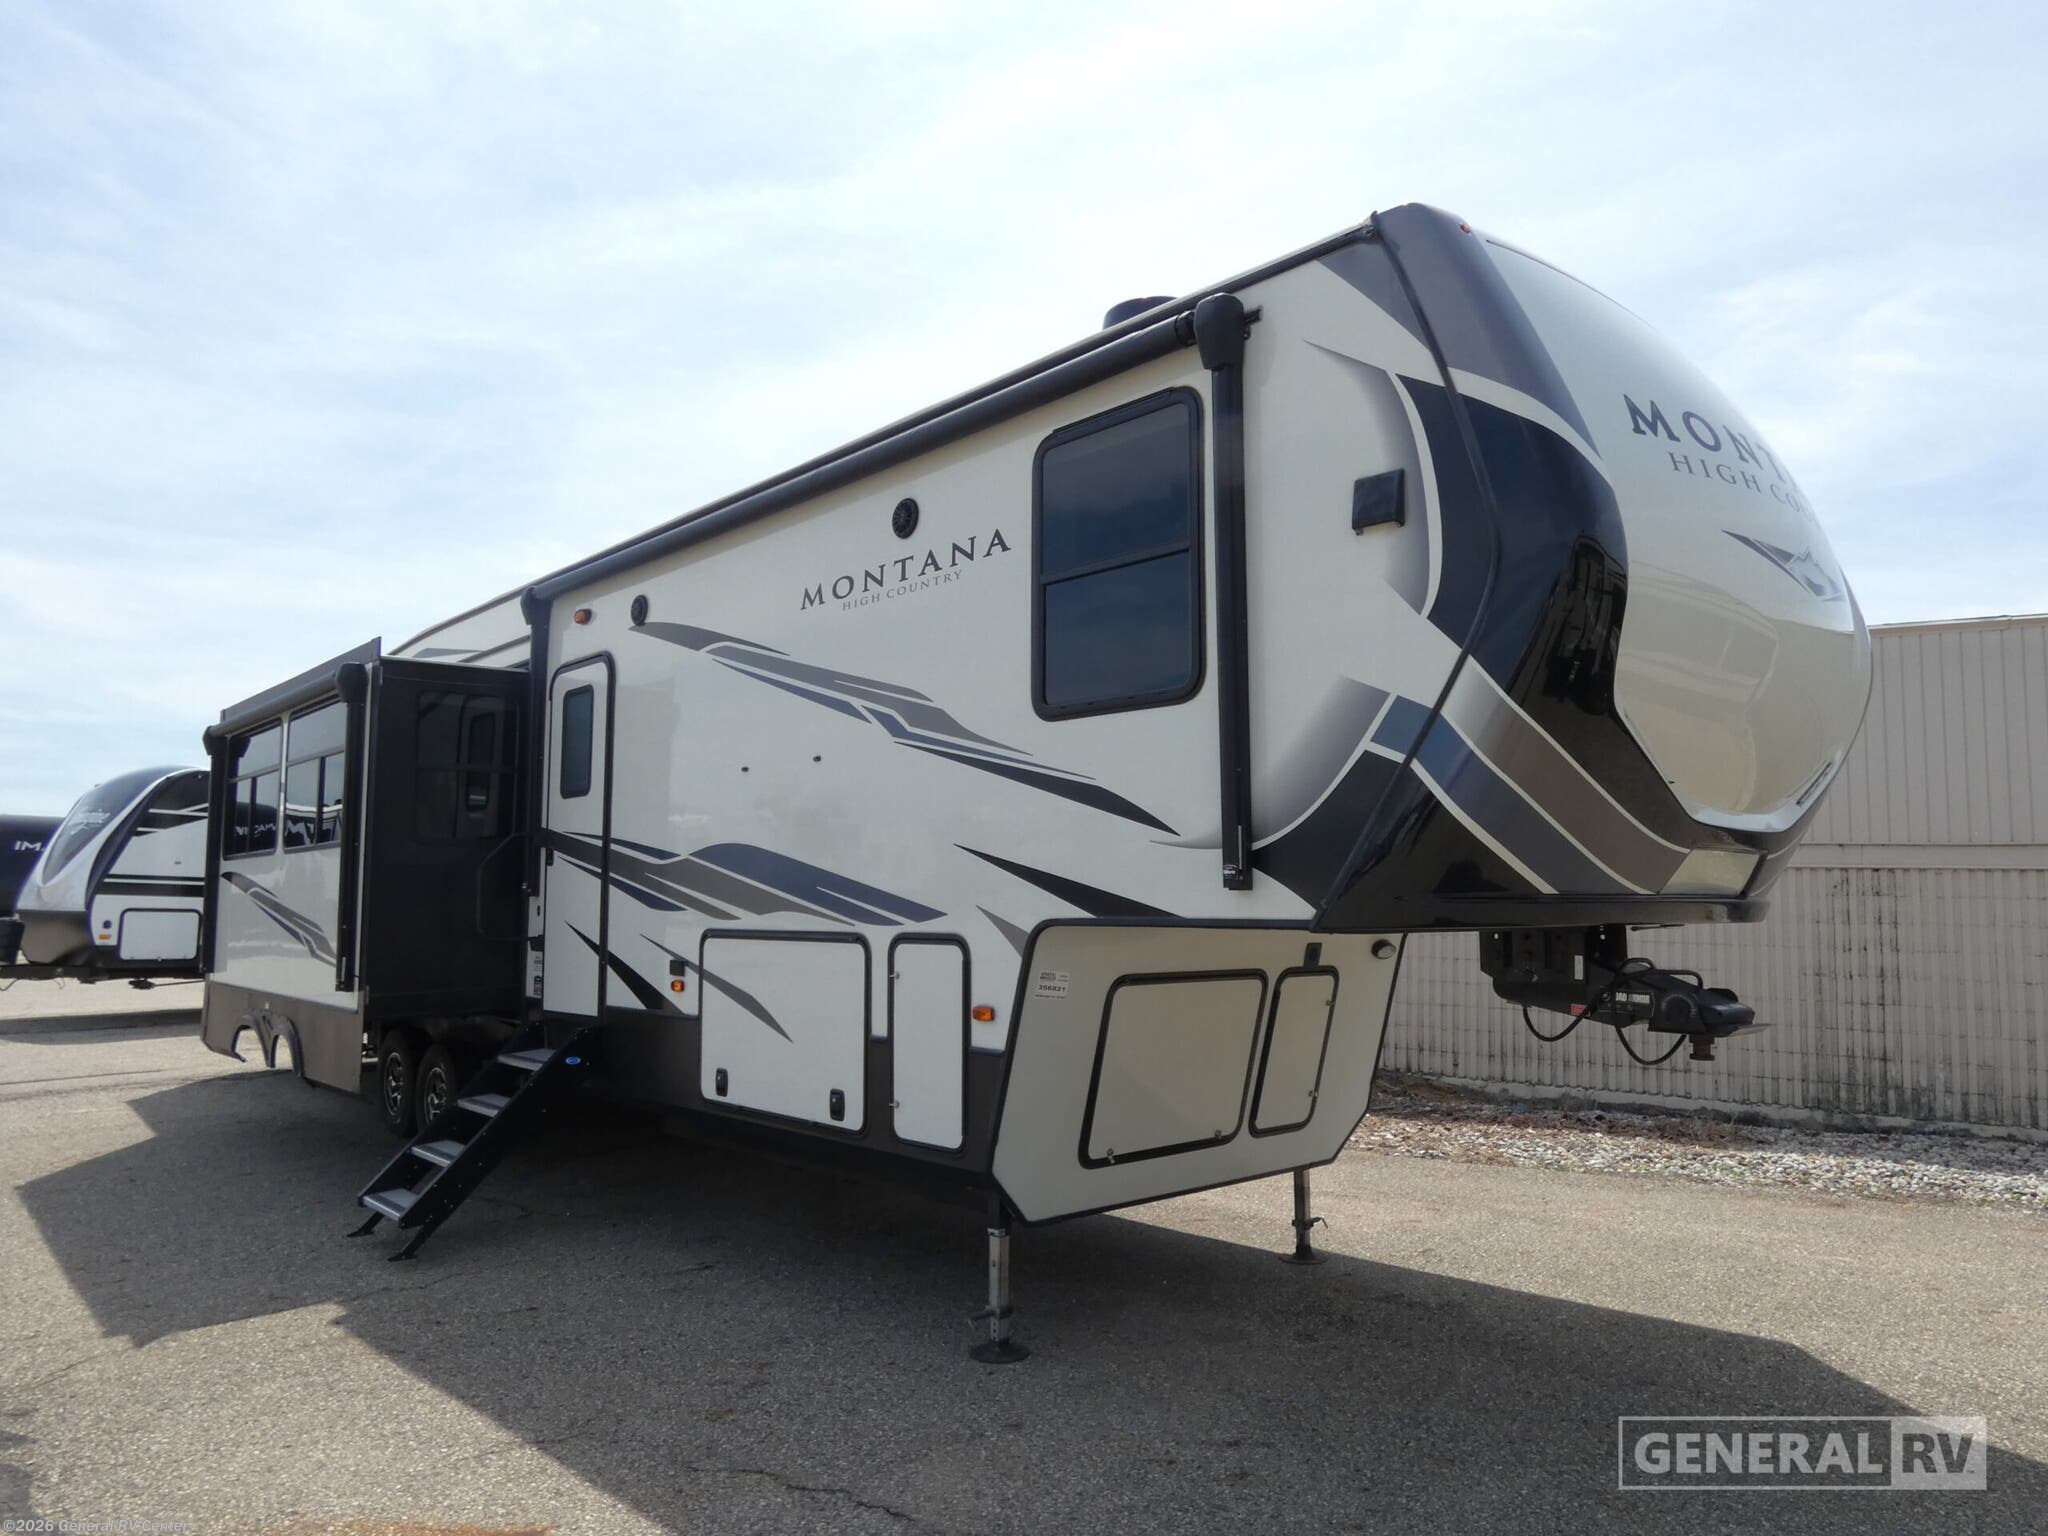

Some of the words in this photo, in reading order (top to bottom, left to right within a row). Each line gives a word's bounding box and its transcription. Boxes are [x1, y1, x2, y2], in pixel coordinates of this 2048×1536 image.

[1623, 393, 1790, 485] MONT
[1667, 451, 1762, 494] HIGH
[800, 528, 1012, 610] MONTANA
[842, 592, 881, 611] HIGH
[886, 569, 962, 599] COUNTRY
[15, 840, 46, 851] IM
